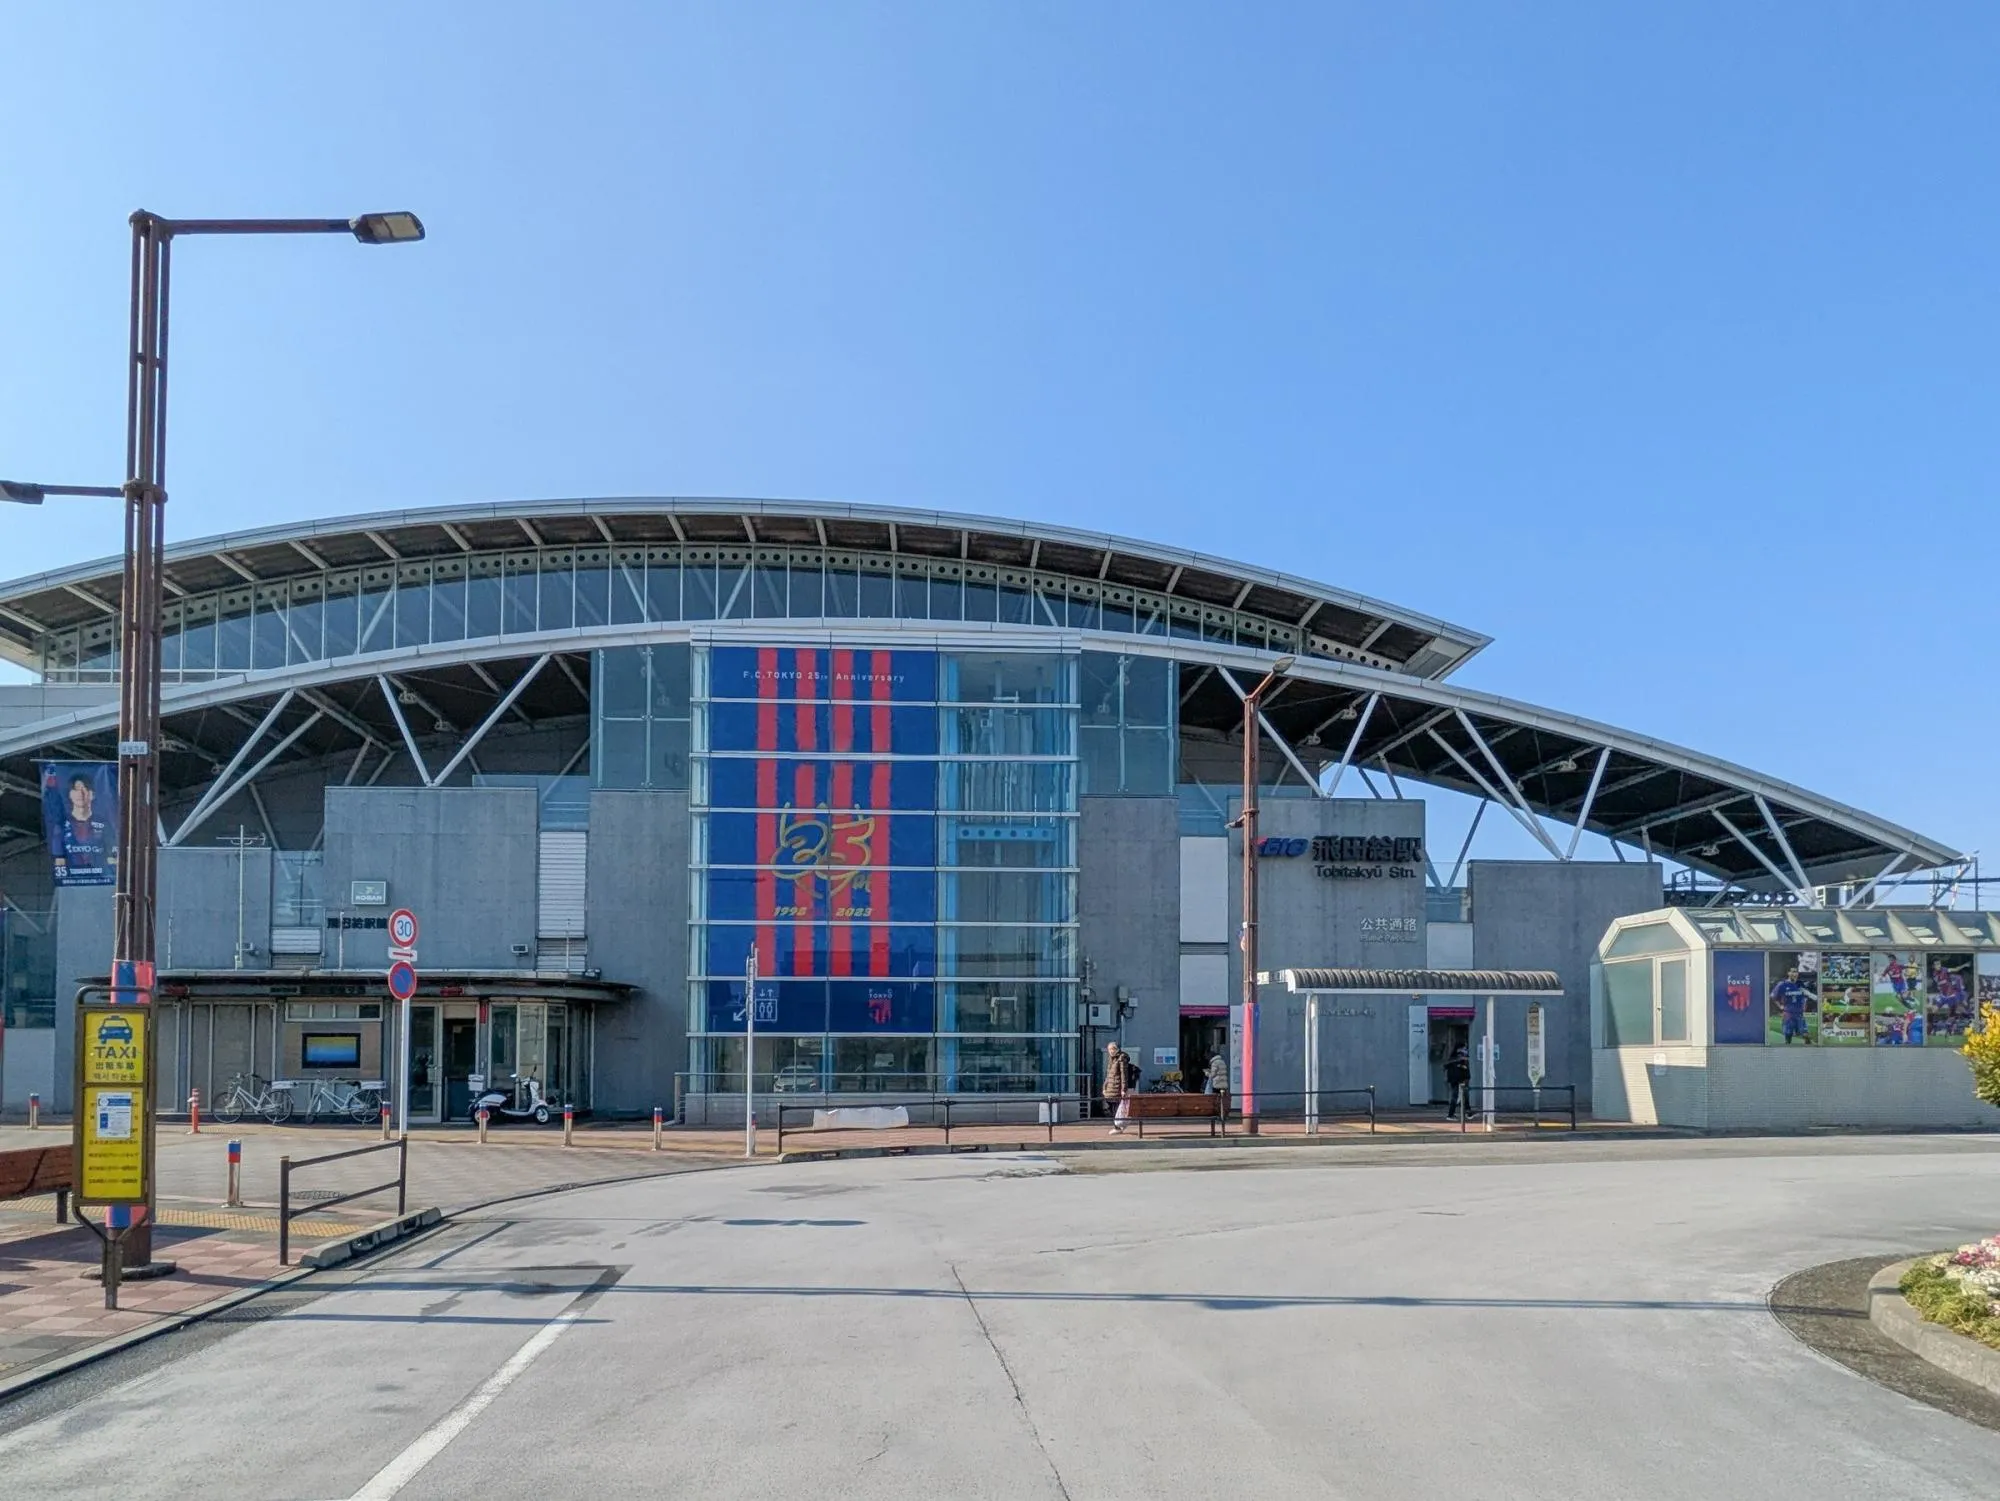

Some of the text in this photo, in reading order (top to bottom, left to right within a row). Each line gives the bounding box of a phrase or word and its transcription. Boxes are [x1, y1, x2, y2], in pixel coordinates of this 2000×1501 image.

[836, 674, 904, 683] Anniversary
[55, 866, 67, 876] 35
[1389, 866, 1416, 879] Stn.
[397, 920, 412, 938] 30
[1360, 917, 1417, 931] 公共通路
[94, 1046, 137, 1059] TAXI
